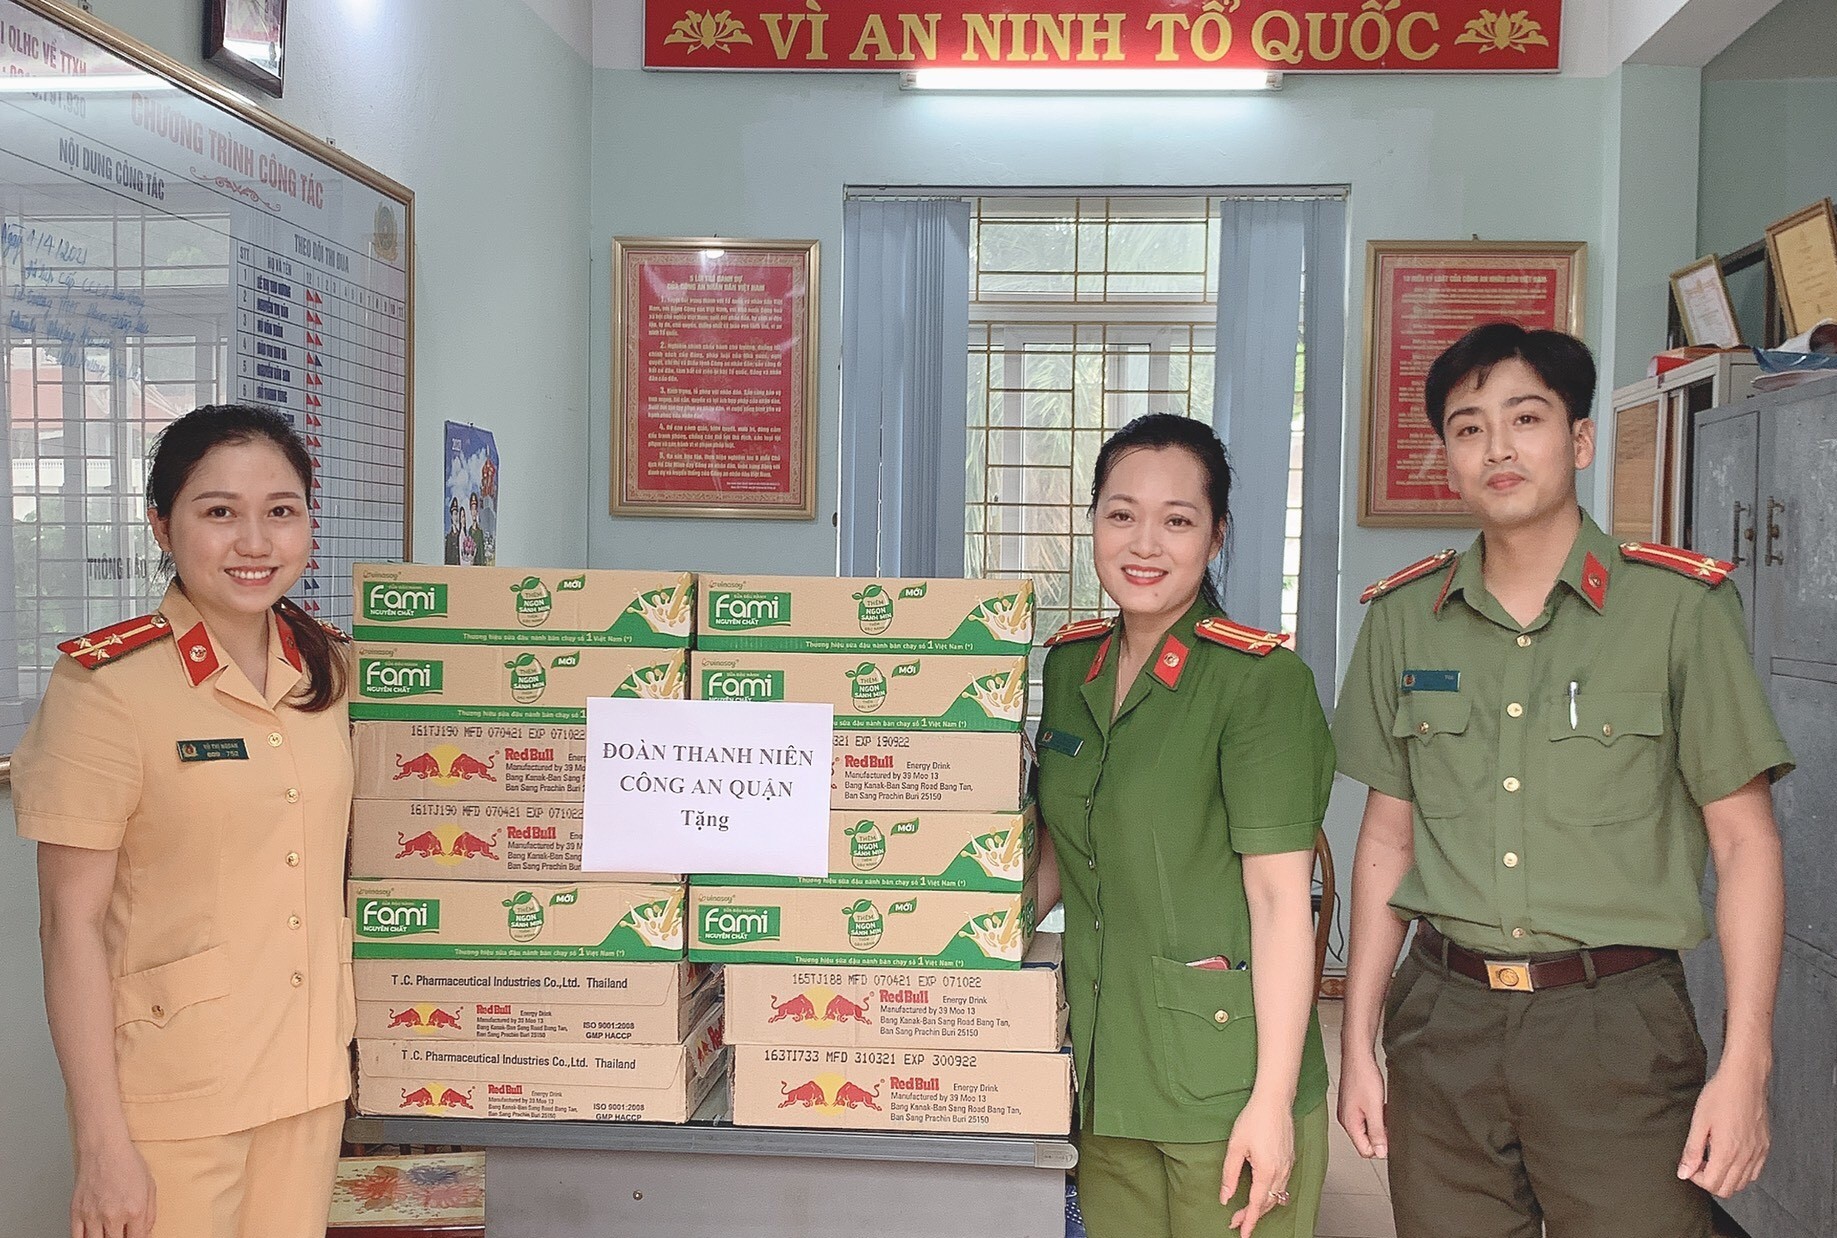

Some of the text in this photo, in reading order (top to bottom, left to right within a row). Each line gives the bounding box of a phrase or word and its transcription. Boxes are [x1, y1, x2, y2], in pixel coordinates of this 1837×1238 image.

[759, 0, 1440, 65] VÌ AN NINH TỔ QUỐC
[131, 92, 204, 155] CHƯƠNG
[208, 131, 254, 178] TRÌNH
[259, 153, 297, 198] CÔNG
[300, 172, 324, 210] TÁC
[59, 137, 165, 201] NỘI DUNG CÔNG TÁC
[294, 233, 312, 258] THEO
[239, 246, 250, 262] STT
[87, 552, 123, 580] THÔNG
[563, 579, 582, 589] MỚI
[370, 585, 435, 610] Fami
[905, 587, 924, 597] MỚI
[715, 593, 779, 619] Fami
[397, 608, 415, 617] CHẤT
[741, 618, 760, 626] CHẤT
[558, 656, 576, 667] MỚI
[366, 661, 431, 687] Fami
[898, 665, 916, 675] MỚI
[708, 672, 772, 697] Fami
[464, 726, 483, 738] MFD
[488, 727, 522, 738] 070421
[529, 728, 546, 739] EXP
[551, 728, 585, 741] 071022
[855, 735, 910, 747] EXP 190922
[602, 739, 813, 767] ĐOÀN THANH NIÊN
[906, 761, 931, 770] Energy
[932, 762, 950, 770] Drink
[620, 771, 793, 801] CÔNG AN QUẬN
[462, 805, 481, 817] MFD
[486, 806, 520, 818] 070421
[526, 806, 543, 819] EXP
[681, 809, 730, 831] Tặng
[898, 821, 915, 833] MỚI
[555, 894, 574, 903] MỚI
[895, 902, 913, 911] MỚI
[363, 900, 427, 926] Fami
[704, 907, 768, 933] Fami
[390, 925, 408, 933] CHẤT
[416, 975, 491, 987] Pharmaceutical
[494, 976, 541, 987] Industries
[587, 977, 628, 989] Thailand
[848, 974, 868, 986] MFD
[874, 975, 911, 986] 070421
[918, 975, 937, 987] EXP
[943, 976, 982, 988] 071022
[943, 996, 968, 1005] Energy
[969, 996, 988, 1004] Drink
[880, 1005, 927, 1014] Manufactured
[928, 1006, 938, 1015] by
[598, 1022, 635, 1030] 9001:2008
[880, 1016, 1010, 1028] Bang Kanak-Ban Sang Road Bang Tan,
[605, 1032, 632, 1040] HACCP
[880, 1027, 894, 1035] Ban
[895, 1028, 913, 1037] Sang
[914, 1028, 940, 1036] Prachin
[957, 1029, 978, 1037] 25150
[425, 1051, 500, 1064] Pharmaceutical
[503, 1055, 550, 1066] Industries
[595, 1057, 636, 1069] Thailand
[826, 1051, 848, 1063] MFD
[854, 1052, 896, 1064] 310321
[904, 1054, 925, 1066] EXP
[932, 1055, 977, 1067] 300922
[953, 1083, 978, 1093] Energy
[980, 1084, 998, 1092] Drink
[891, 1092, 938, 1101] Manufactured
[939, 1093, 948, 1102] by
[949, 1094, 959, 1102] 39
[960, 1094, 976, 1102] Moo
[593, 1103, 645, 1112] ISO 9001:2008
[891, 1103, 1021, 1115] Bang Kanak-Ban Sang Road Bang Tan,
[596, 1113, 642, 1121] GMP HACCP
[891, 1113, 904, 1121] Ban
[906, 1114, 923, 1122] Sang
[925, 1114, 950, 1122] Prachin
